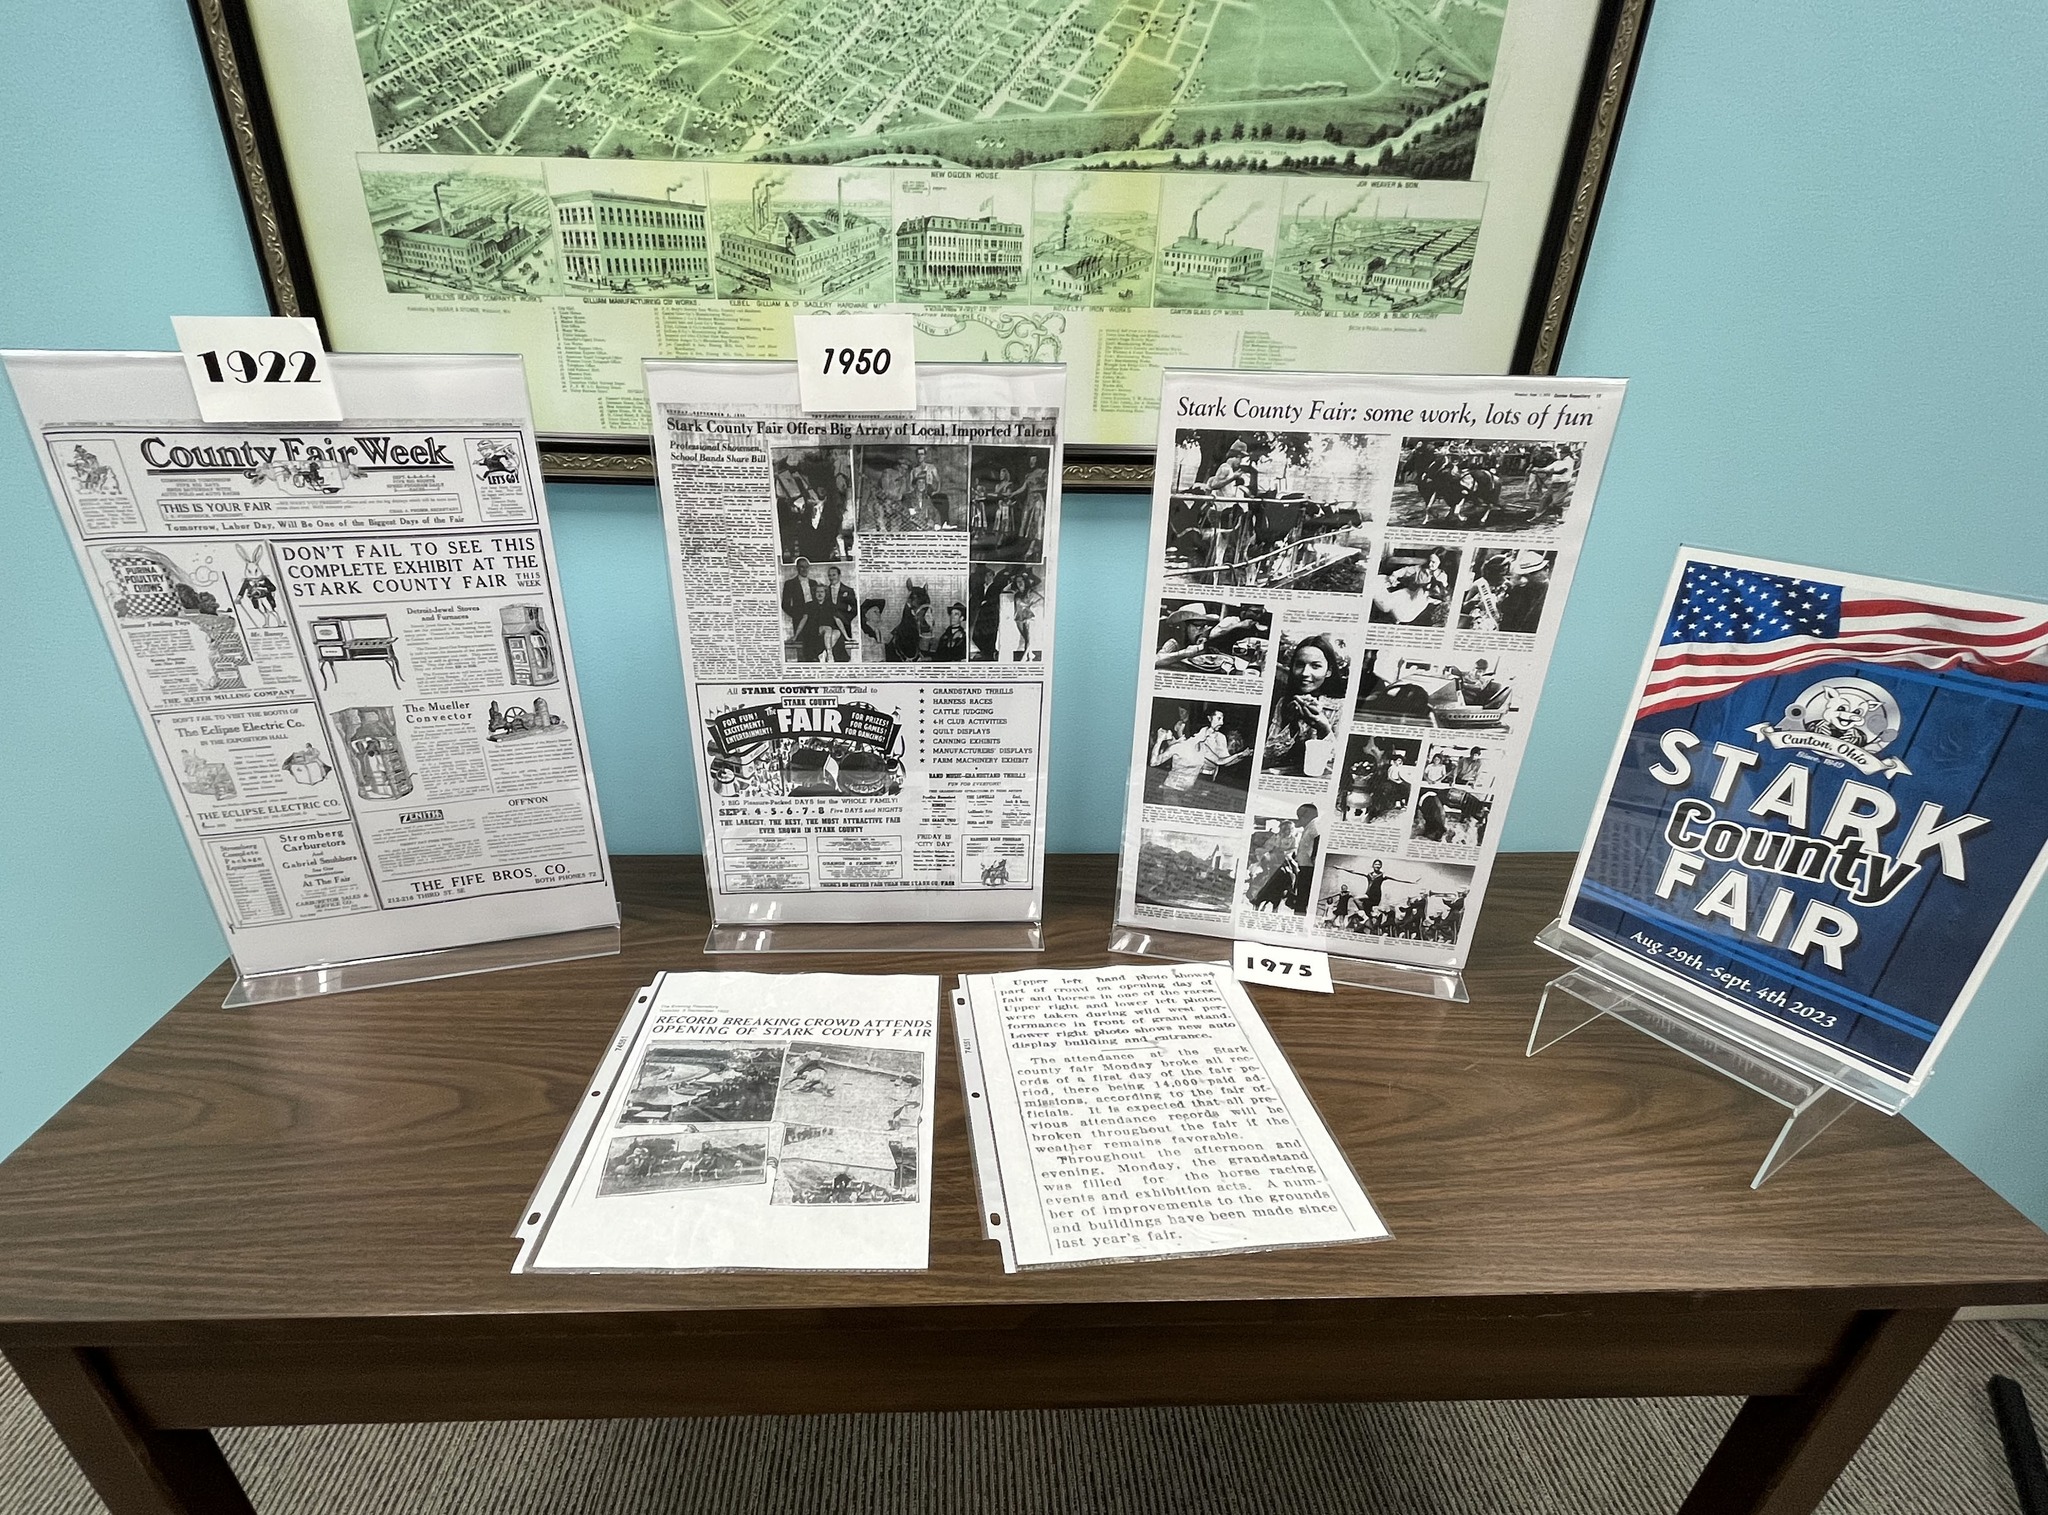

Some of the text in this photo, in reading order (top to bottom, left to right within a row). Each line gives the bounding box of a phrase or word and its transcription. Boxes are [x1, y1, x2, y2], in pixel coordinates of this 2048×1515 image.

[197, 350, 321, 383] 1922
[823, 348, 891, 375] 1950
[1177, 396, 1593, 430] Stark County Fair: some work, lots of fun
[667, 417, 1056, 440] Stark County Fair Offers Big Array of Local, Imported Talent
[141, 437, 453, 468] County Fair Week
[670, 441, 720, 451] Professional
[670, 452, 766, 463] School Bands Share Bill
[488, 475, 505, 485] LET'S
[161, 501, 272, 513] THIS IS YOUR FAIR
[277, 520, 298, 529] Will
[301, 520, 313, 528] Be
[317, 520, 334, 528] One
[368, 519, 396, 527] Biggest
[400, 518, 419, 526] Days
[282, 538, 535, 561] DON'T FAIL TO SEE THIS
[125, 566, 157, 575] PURINA
[288, 555, 538, 578] COMPLETE EXHIBIT AT THE
[125, 574, 164, 584] POULTRY
[516, 572, 540, 580] THIS
[517, 579, 541, 587] WEEK
[294, 574, 507, 597] STARK COUNTY FAIR
[254, 689, 296, 698] COMPANY
[403, 701, 470, 713] The Mueller
[406, 712, 473, 724] Convector
[722, 713, 758, 726] FOR FUN!
[776, 708, 842, 733] FAIR
[851, 712, 889, 726] FOR PRIZES!
[201, 721, 283, 737] Eclipse Electric
[724, 720, 765, 736] EXCITEMENT!
[850, 720, 888, 735] FOR GAMES!
[1782, 734, 1867, 765] Canton, Ohio
[222, 802, 321, 819] ECLIPSE ELECTRIC
[719, 807, 750, 816] SEPT.
[1648, 727, 1991, 881] STARK
[280, 829, 344, 843] Stromberg
[283, 840, 346, 852] Carburetors
[1664, 798, 1922, 908] County
[282, 858, 318, 869] Gabriel
[411, 863, 571, 893] THE FIFE BROS. CO.
[1654, 847, 1859, 972] FAIR
[1247, 957, 1312, 977] 1975
[1630, 930, 1663, 956] Aug.
[1665, 945, 1704, 973] 29th
[1757, 985, 1787, 1008] 4th
[1788, 999, 1838, 1030] 2023
[1004, 1004, 1041, 1012] Upper
[1049, 1003, 1079, 1011] right
[1115, 999, 1148, 1008] lower
[656, 1016, 933, 1028] RECORD BREAKING CROWD ATTENDS
[652, 1025, 932, 1037] OPENING OF STARK COUNTY FAIR
[1056, 1029, 1088, 1038] right
[1094, 1027, 1129, 1037] photo
[1017, 1058, 1198, 1077] county fair Monday broke
[1063, 1084, 1099, 1094] there
[1108, 1081, 1145, 1092] being
[1127, 1098, 1218, 1113] expected that
[1091, 1124, 1172, 1139] throughout
[1229, 1151, 1310, 1166] grandstand
[1083, 1164, 1317, 1189] filled horse racing
[1103, 1198, 1212, 1217] improvements
[1089, 1203, 1338, 1231] buildings been made since
[1092, 1229, 1182, 1248] year's fair.
